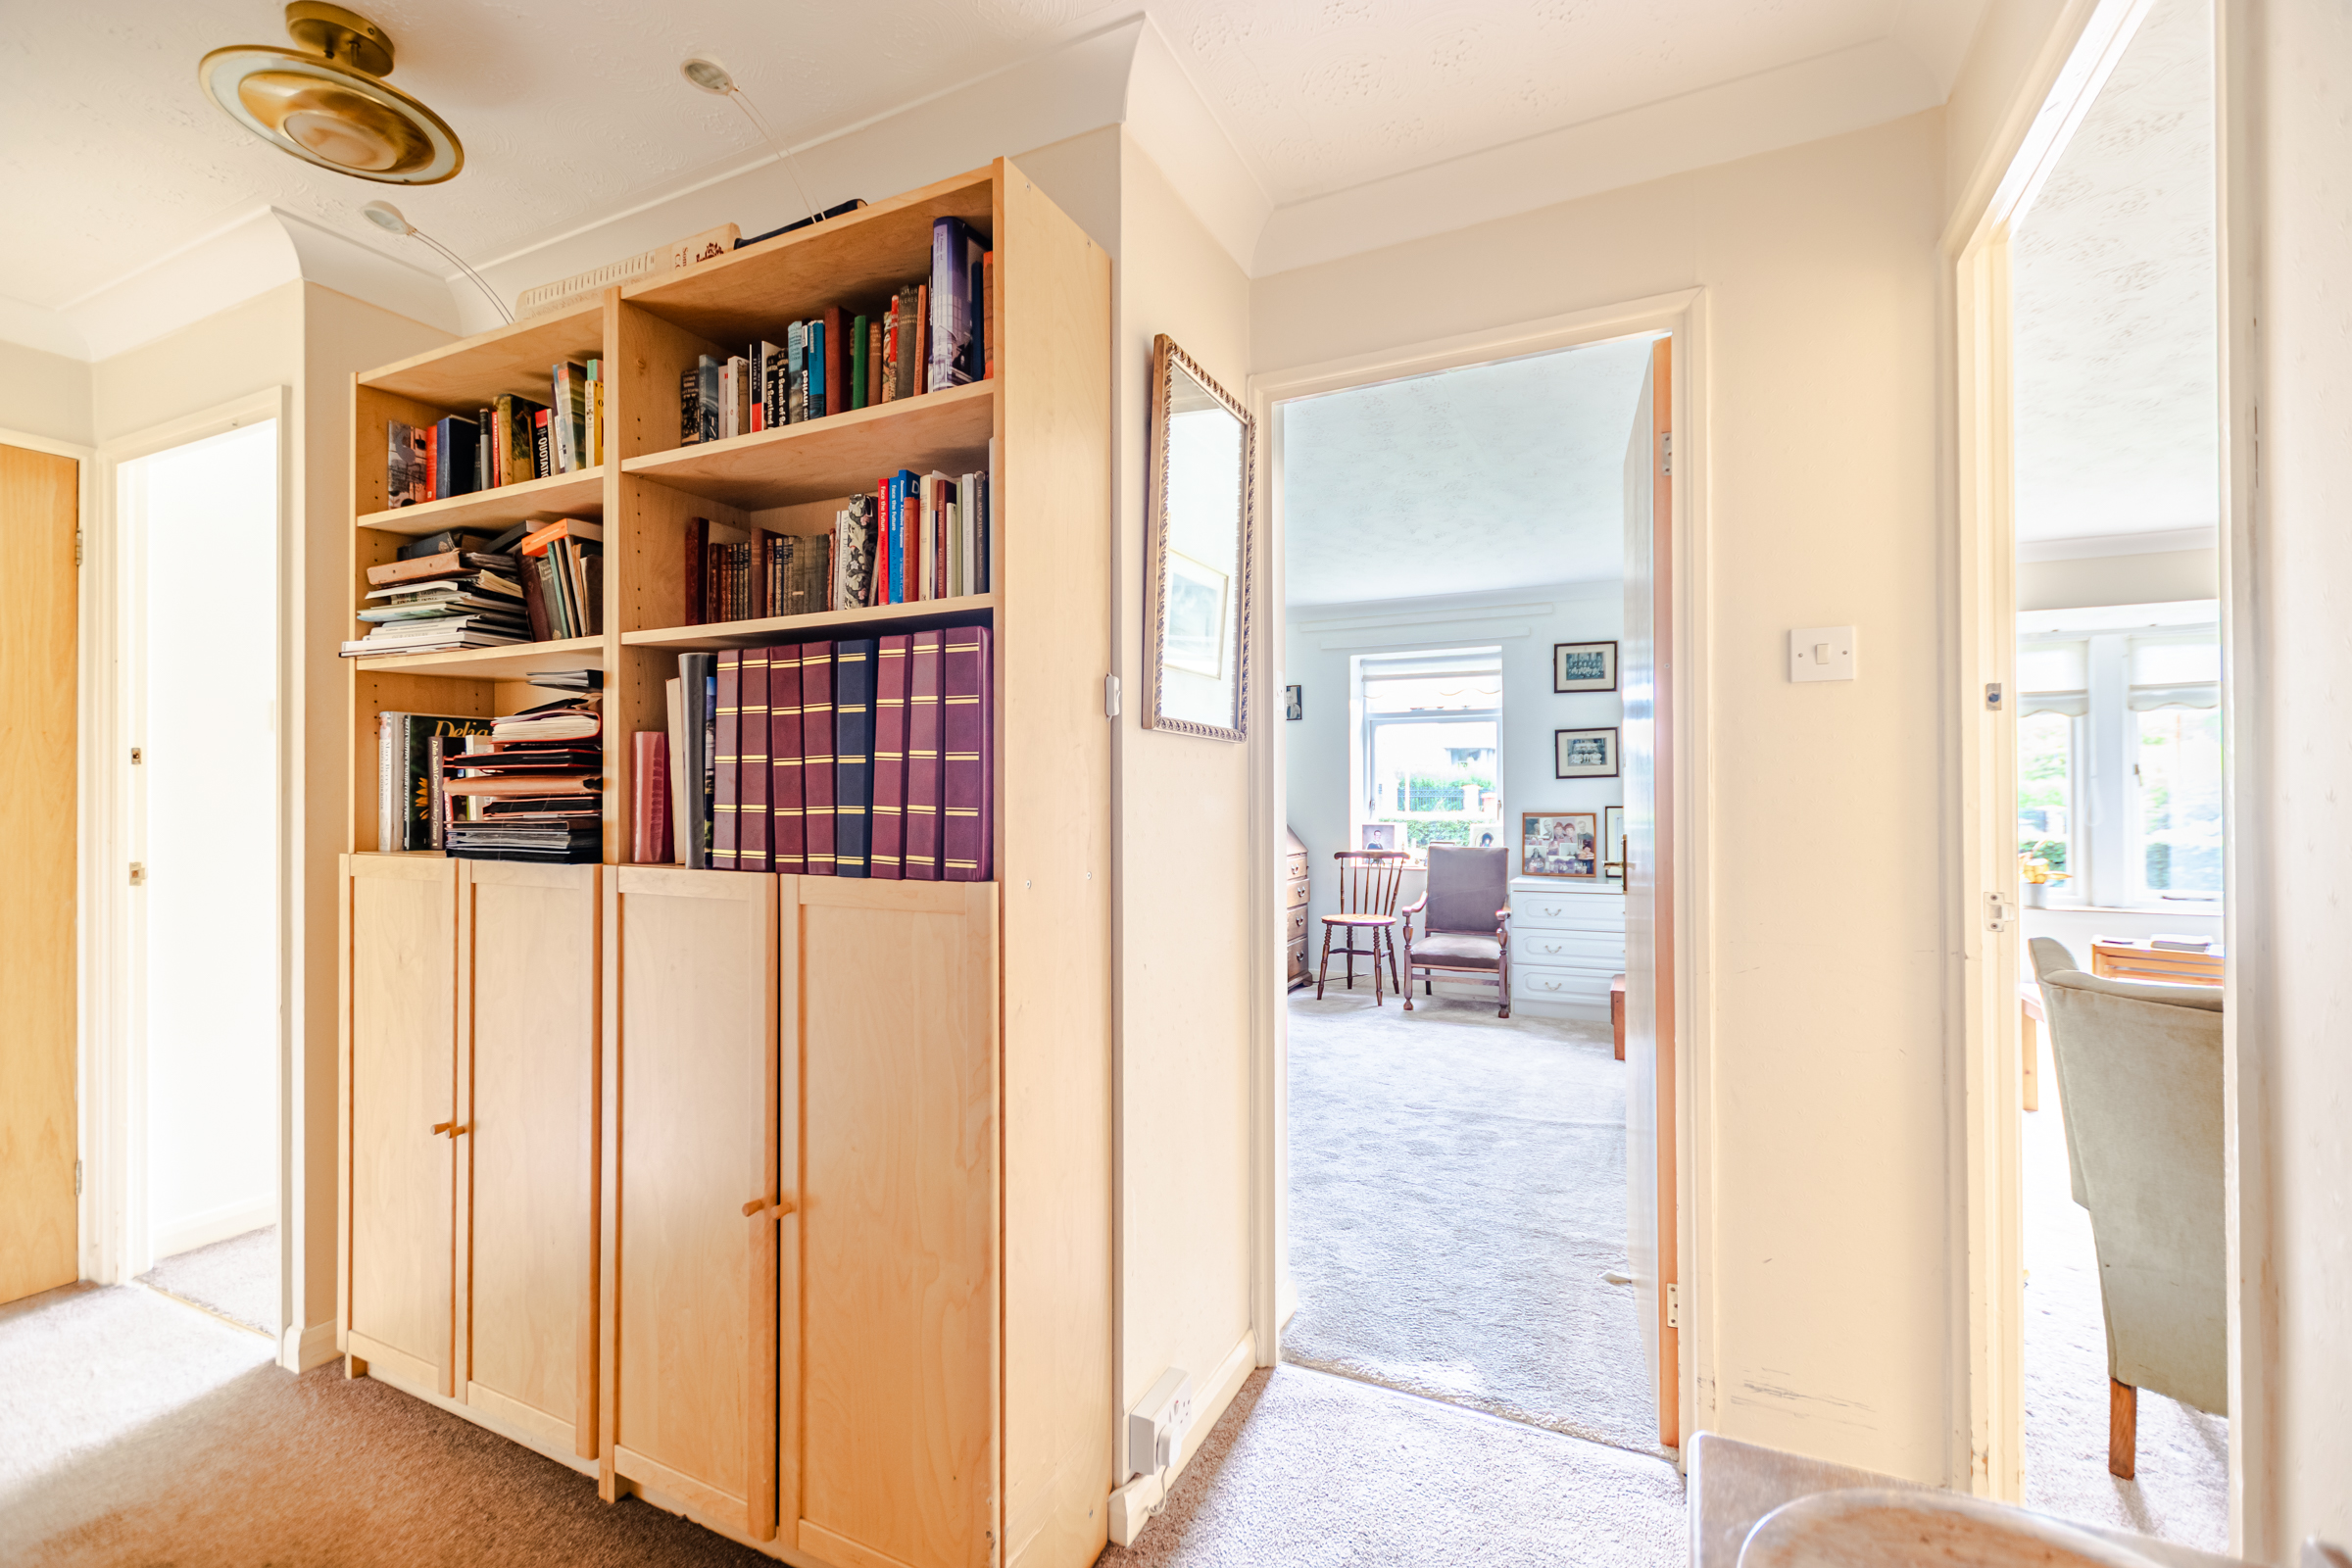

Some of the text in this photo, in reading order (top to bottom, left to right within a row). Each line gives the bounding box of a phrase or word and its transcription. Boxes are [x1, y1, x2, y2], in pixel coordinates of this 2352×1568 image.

[778, 368, 785, 377] In
[767, 380, 774, 389] In
[778, 407, 786, 416] of
[435, 720, 488, 737] Delia
